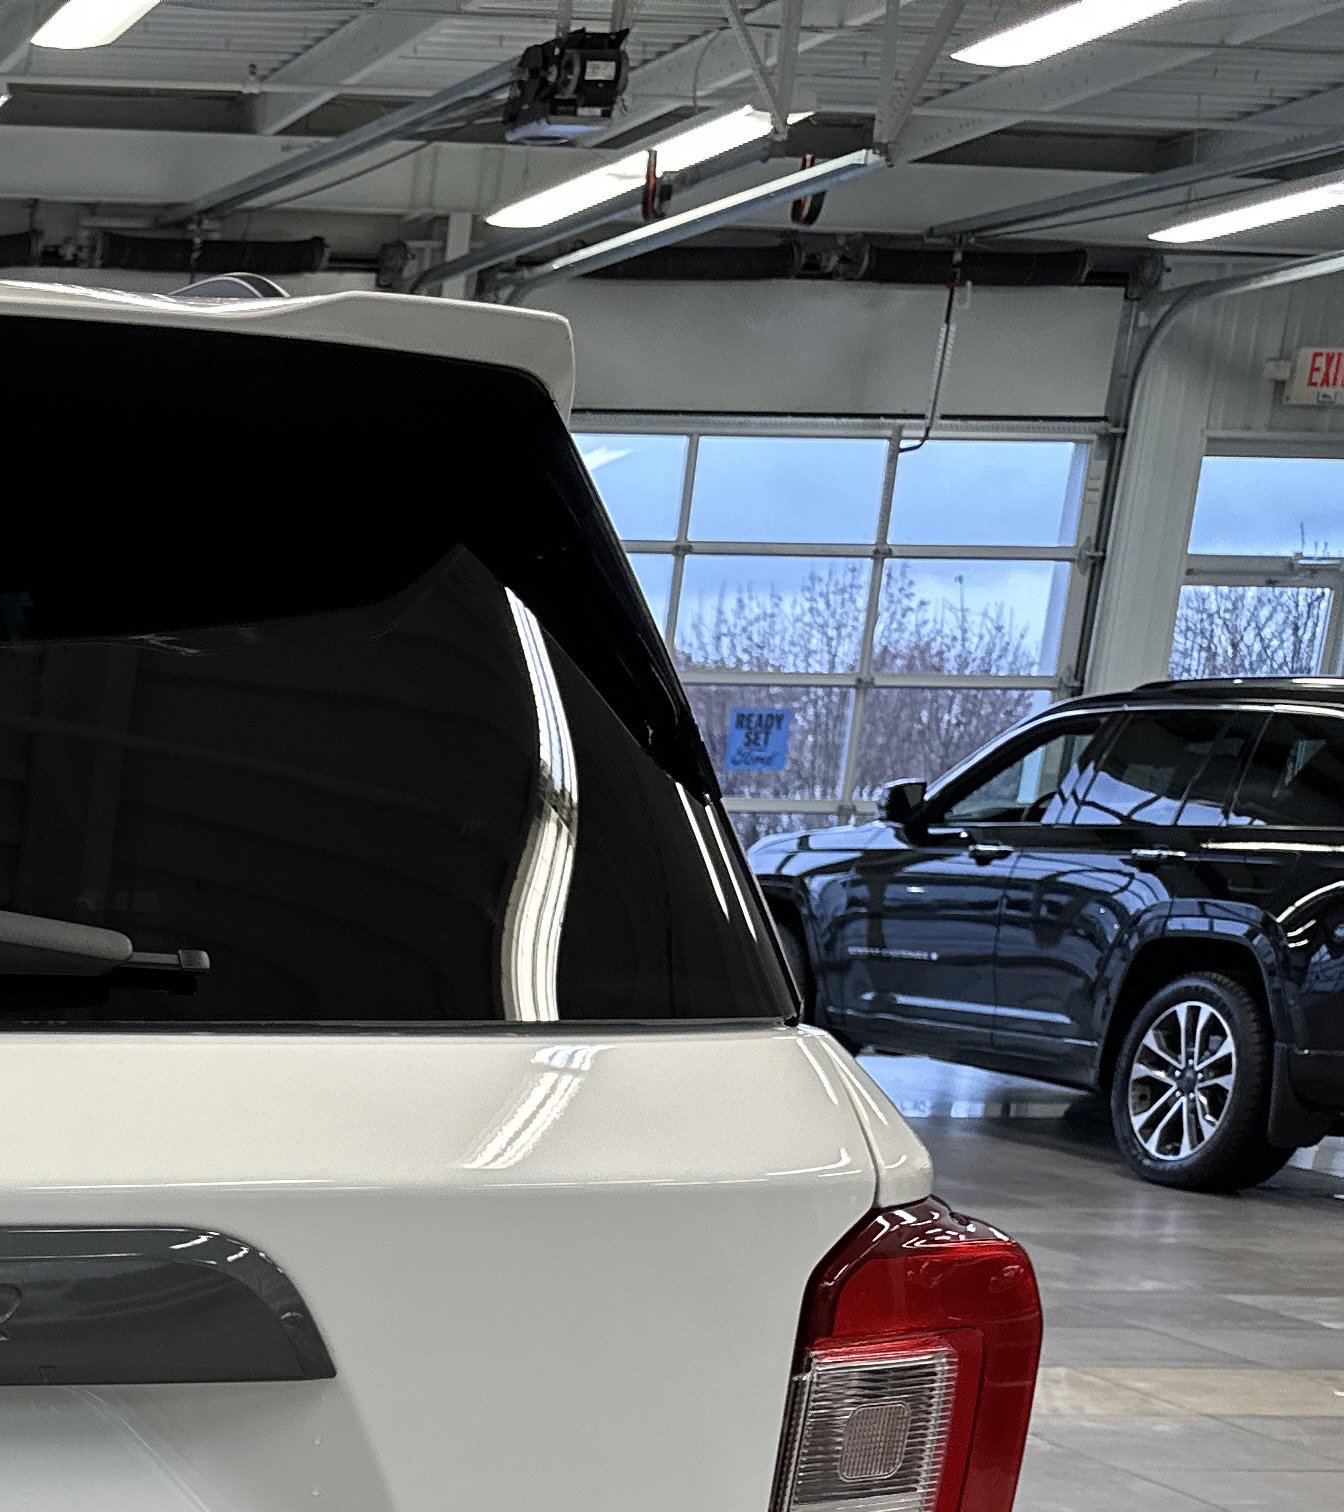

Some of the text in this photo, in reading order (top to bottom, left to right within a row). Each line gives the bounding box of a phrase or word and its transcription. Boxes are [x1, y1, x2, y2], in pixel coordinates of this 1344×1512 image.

[1307, 351, 1344, 387] EXI
[735, 713, 785, 730] READY
[743, 731, 772, 748] SET
